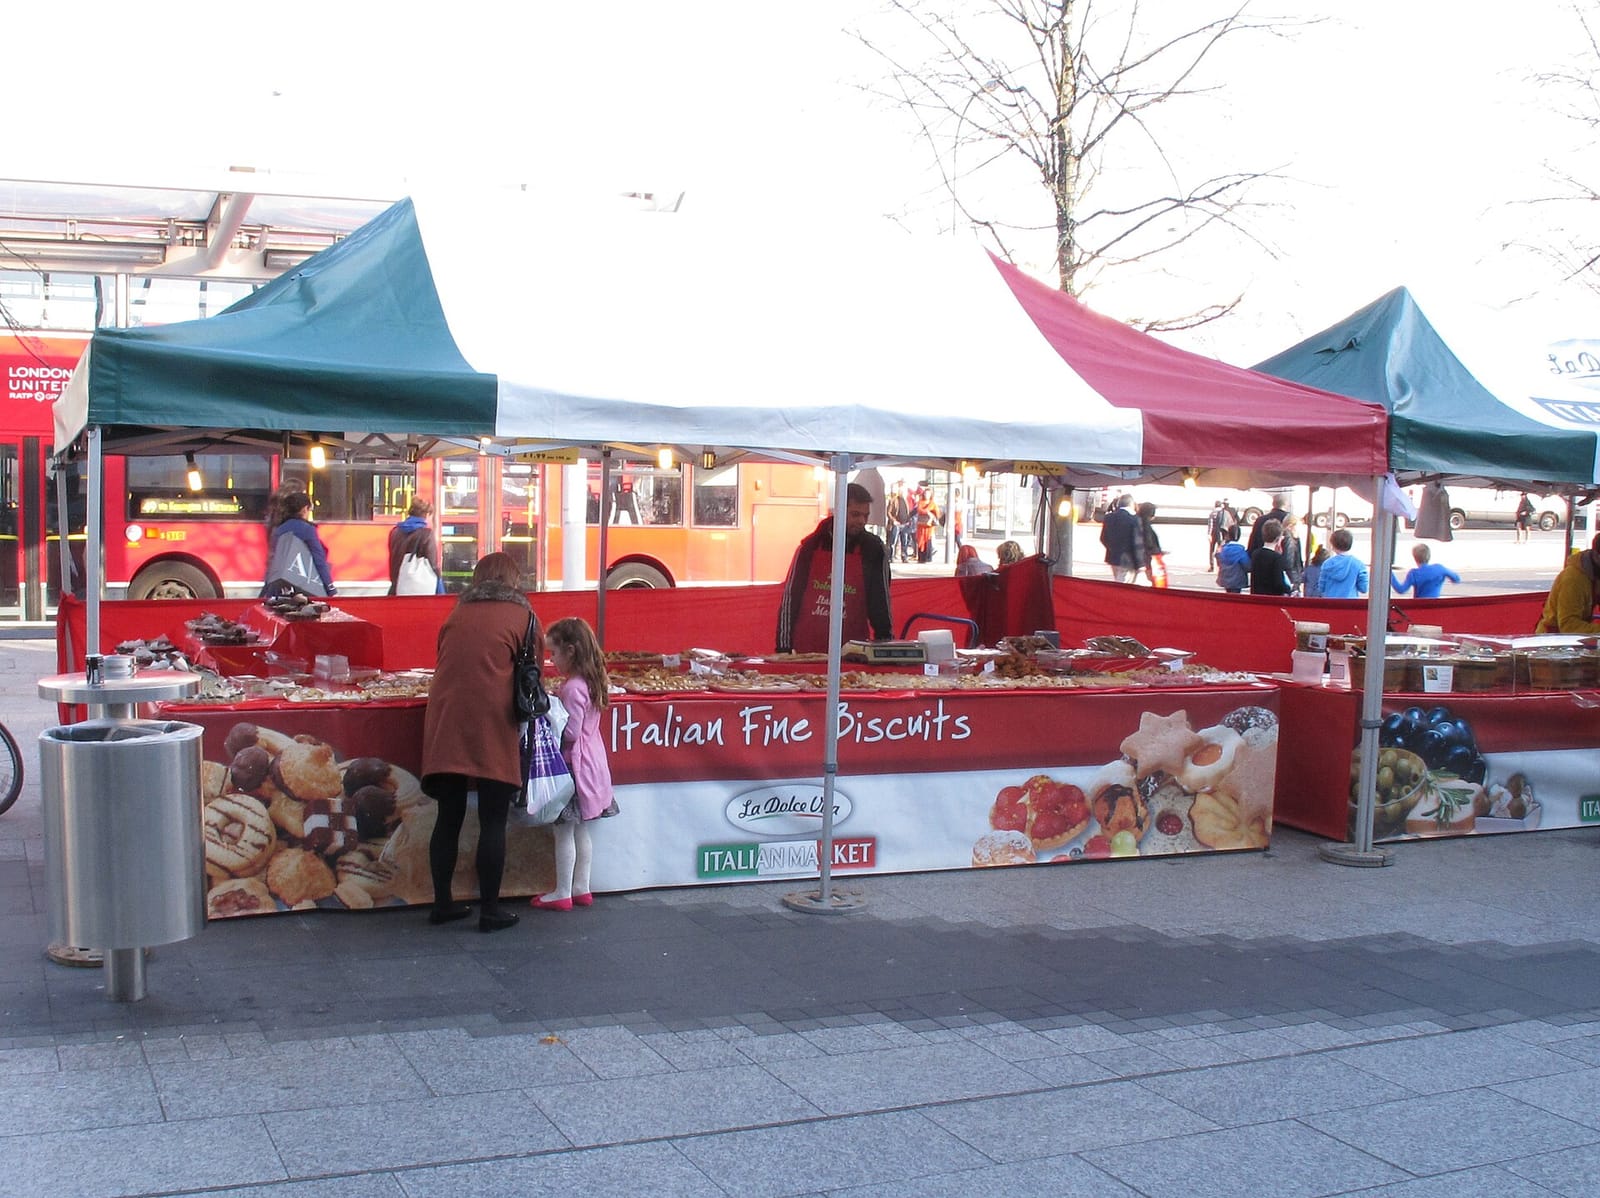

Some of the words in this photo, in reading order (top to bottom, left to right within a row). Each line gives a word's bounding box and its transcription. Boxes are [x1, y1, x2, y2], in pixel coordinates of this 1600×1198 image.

[8, 366, 73, 379] LONDON
[8, 391, 34, 400] RATP
[611, 703, 725, 753] Italian
[738, 704, 813, 747] Fine
[836, 698, 972, 743] Biscuits
[737, 799, 761, 819] La
[763, 795, 807, 814] Dolce
[703, 846, 786, 873] ITALIAN
